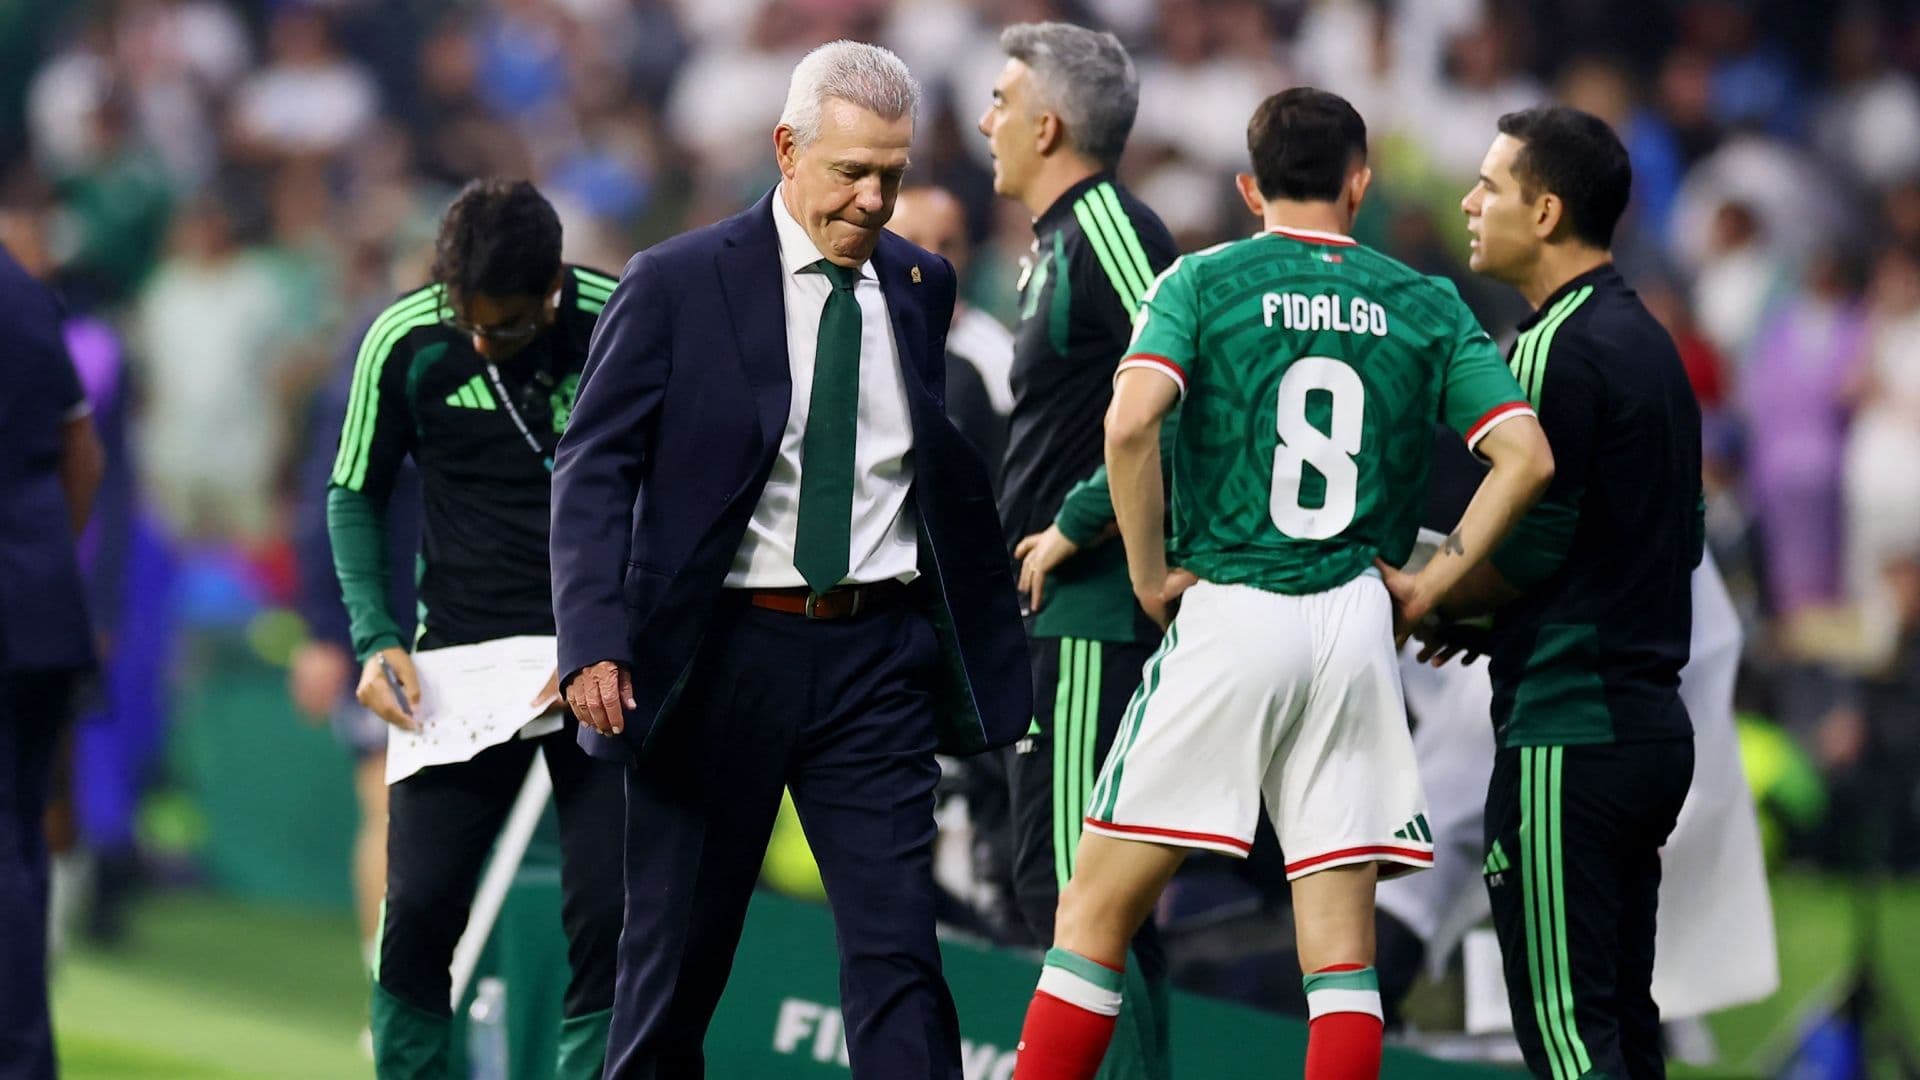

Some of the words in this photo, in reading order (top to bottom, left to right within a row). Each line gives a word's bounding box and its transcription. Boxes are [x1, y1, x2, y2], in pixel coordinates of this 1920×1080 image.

[1262, 293, 1388, 337] FIDALGO
[1269, 356, 1365, 540] 8
[773, 997, 850, 1067] FI
